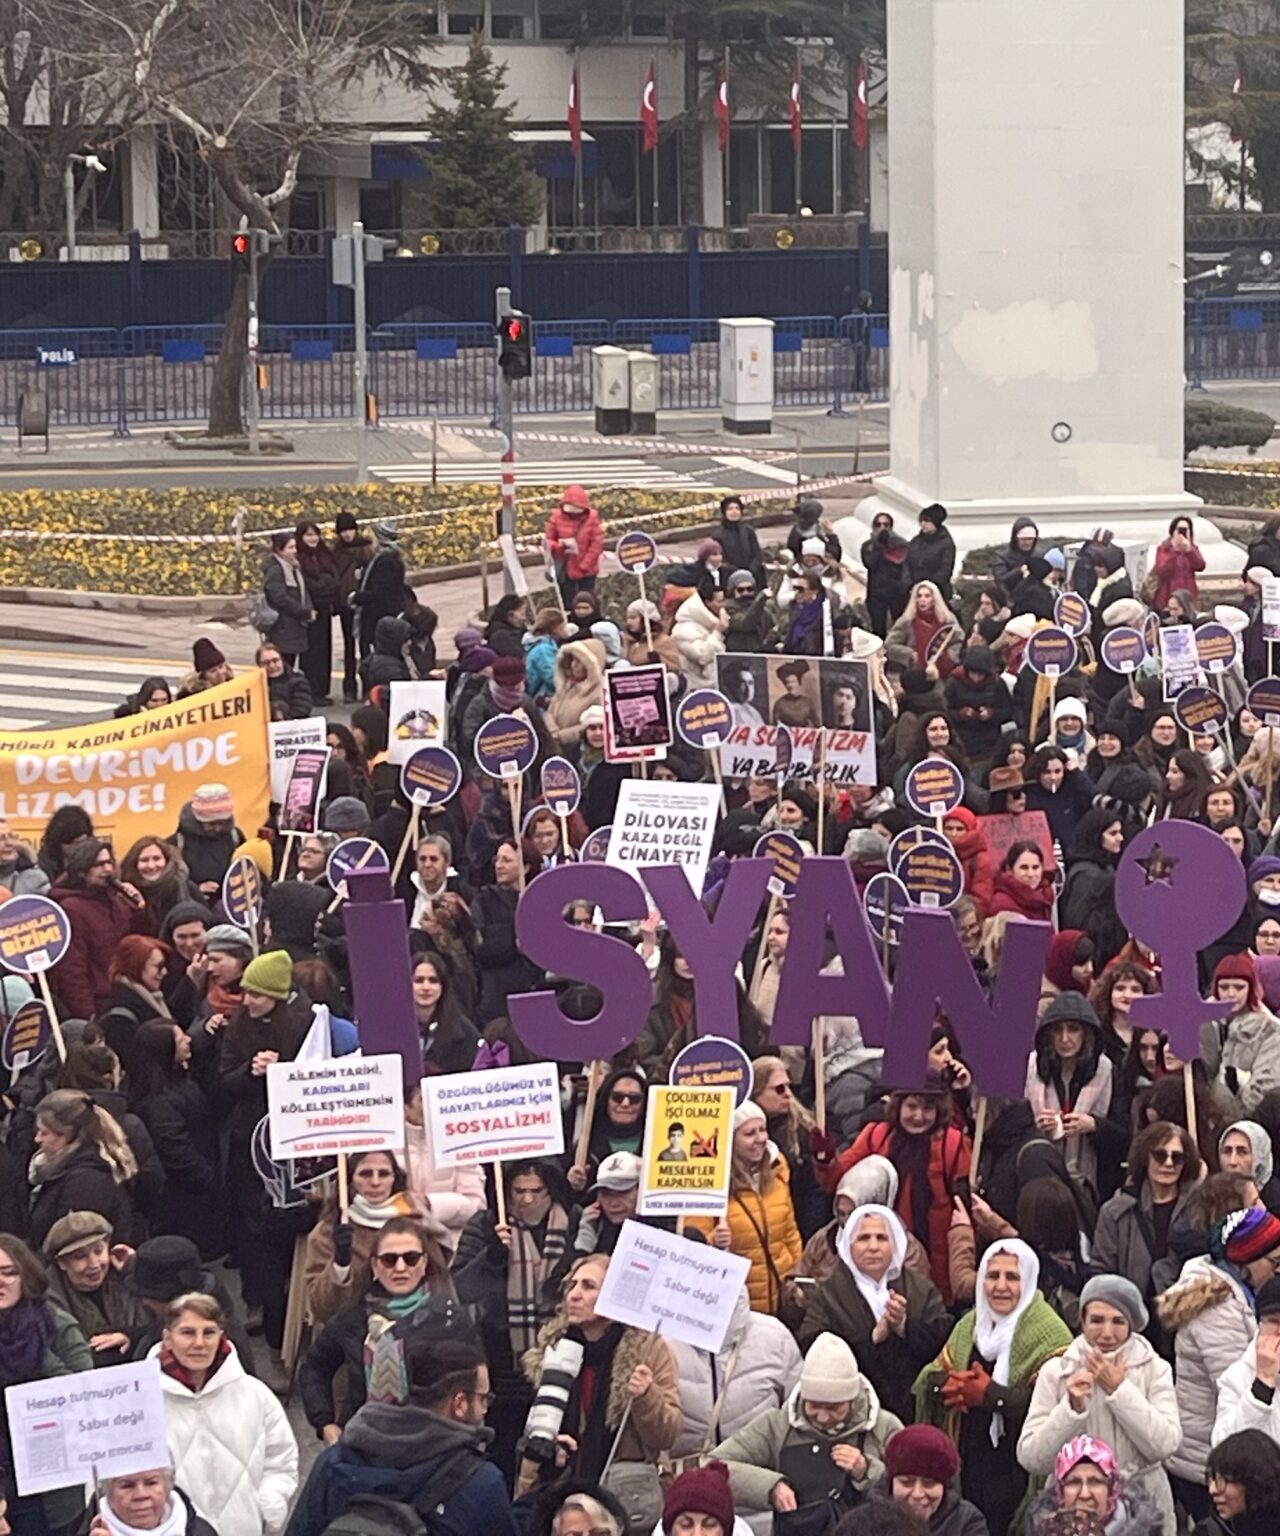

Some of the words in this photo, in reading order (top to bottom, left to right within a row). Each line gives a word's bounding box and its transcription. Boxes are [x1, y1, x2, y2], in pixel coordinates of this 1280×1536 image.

[41, 348, 75, 363] POLİS
[67, 729, 125, 750] KADIN
[130, 688, 252, 738] CİNAYETLERİ
[15, 731, 241, 785] DEVRİMDE
[624, 810, 708, 831] DİLOVASI
[621, 831, 659, 845] KAZA
[663, 832, 703, 847] DEĞİL
[618, 845, 701, 865] CİNAYET!
[287, 1067, 337, 1082] AİLENİN
[302, 1081, 371, 1096] KADINLARI
[437, 1078, 535, 1100] ÖZGÜRLÜĞÜMÜZ
[537, 1077, 553, 1087] VE
[665, 1091, 721, 1107] ÇOCUKTAN
[280, 1093, 394, 1114] KÖLELEŞTİRMENİN
[439, 1095, 527, 1115] HAYATLARIMIZ
[528, 1092, 553, 1106] İÇİN
[685, 1107, 721, 1119] OLMAZ
[306, 1113, 371, 1128] TARİHİDİR!
[444, 1110, 552, 1137] SOSYALİZM!
[656, 1177, 716, 1189] KAPATILSIN
[633, 1236, 668, 1259] Hesap
[669, 1249, 720, 1277] tutmuyor
[663, 1276, 691, 1296] Sabır
[692, 1286, 720, 1306] değil
[26, 1395, 66, 1412] Hesap
[69, 1383, 129, 1404] tutmuyor
[78, 1418, 110, 1433] Sabır
[112, 1408, 145, 1427] değil
